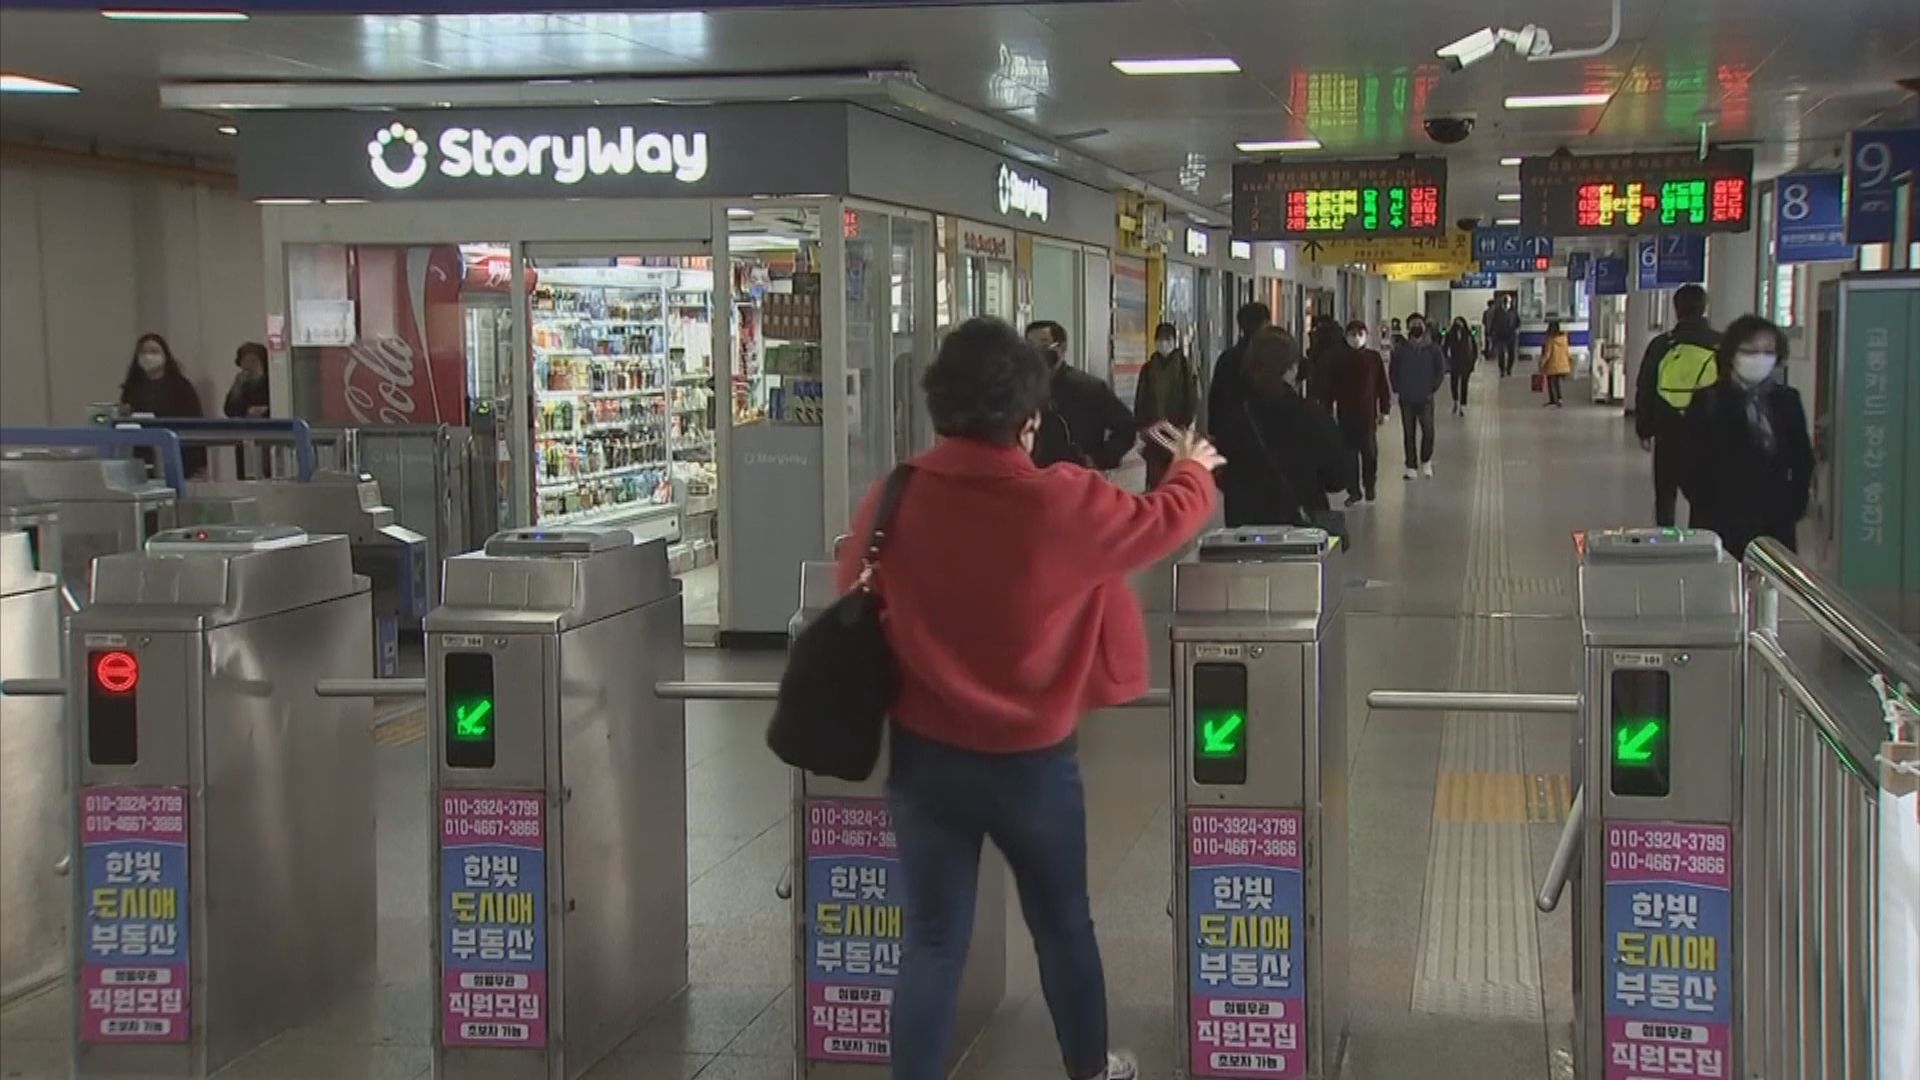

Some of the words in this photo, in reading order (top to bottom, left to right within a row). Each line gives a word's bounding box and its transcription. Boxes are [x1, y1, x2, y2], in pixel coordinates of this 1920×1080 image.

[439, 126, 708, 184] StoryWay
[1857, 142, 1889, 188] 9
[1783, 184, 1809, 221] 8
[1641, 246, 1656, 267] 6
[1667, 234, 1681, 254] 7
[86, 796, 182, 813] 010-3924-3799
[445, 799, 539, 816] 010-3924-3799
[86, 815, 183, 833] 010-4667-3866
[445, 819, 540, 837] 010-4667-3866
[1193, 816, 1297, 836] 010-3924-3799
[1611, 829, 1725, 851] 010-3924-3799
[1193, 838, 1297, 858] 010-4667-3866
[1611, 852, 1725, 874] 010-4667-3866
[105, 851, 161, 884] 한빛
[464, 854, 518, 888] 한빛
[830, 866, 887, 900] 한빛
[92, 887, 178, 919] 도시애
[450, 891, 533, 924] 도시애
[1213, 875, 1273, 910] 한빛
[816, 903, 901, 937] 도시애
[1632, 891, 1698, 929] 한빛
[91, 924, 177, 956] 부동산
[451, 928, 535, 961] 부동산
[1199, 915, 1291, 949] 도시애
[816, 940, 900, 975] 부동산
[1616, 932, 1717, 971] 도시애
[1200, 953, 1290, 988] 부동산
[89, 988, 182, 1014] 직원모집
[449, 992, 539, 1019] 직원모집
[1616, 973, 1717, 1011] 부동산
[1197, 1020, 1297, 1049] 직원모집
[1612, 1043, 1722, 1077] 직원모집
